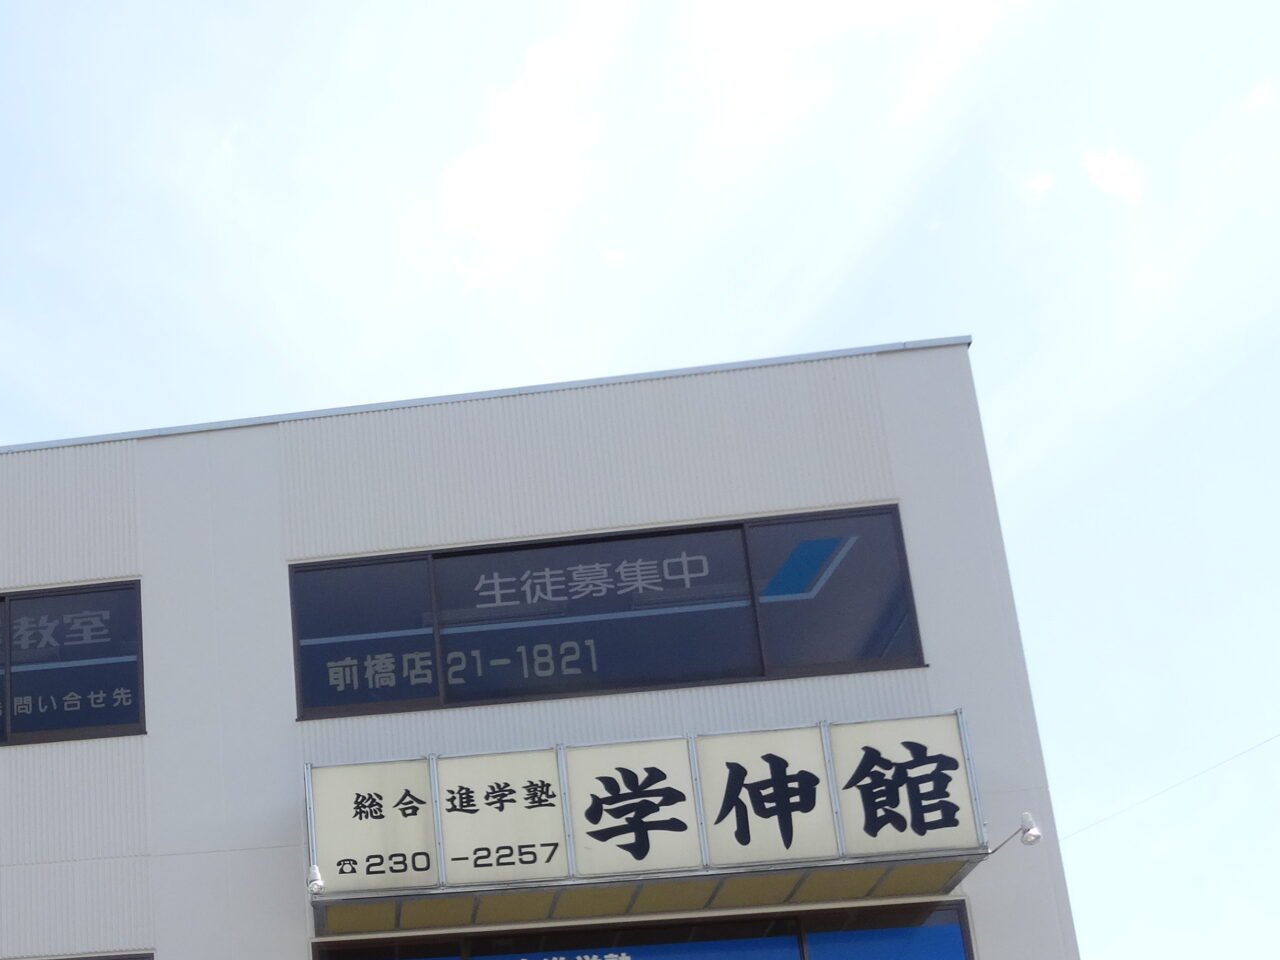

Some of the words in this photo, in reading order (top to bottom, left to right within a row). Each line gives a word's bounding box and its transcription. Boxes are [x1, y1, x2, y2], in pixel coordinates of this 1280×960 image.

[474, 552, 709, 608] 生徒募集中
[327, 652, 433, 691] 前橋店
[447, 640, 598, 685] 21-1821
[352, 779, 557, 821] 総合進学塾
[584, 741, 960, 860] 学伸館
[365, 843, 560, 875] 230-2257
